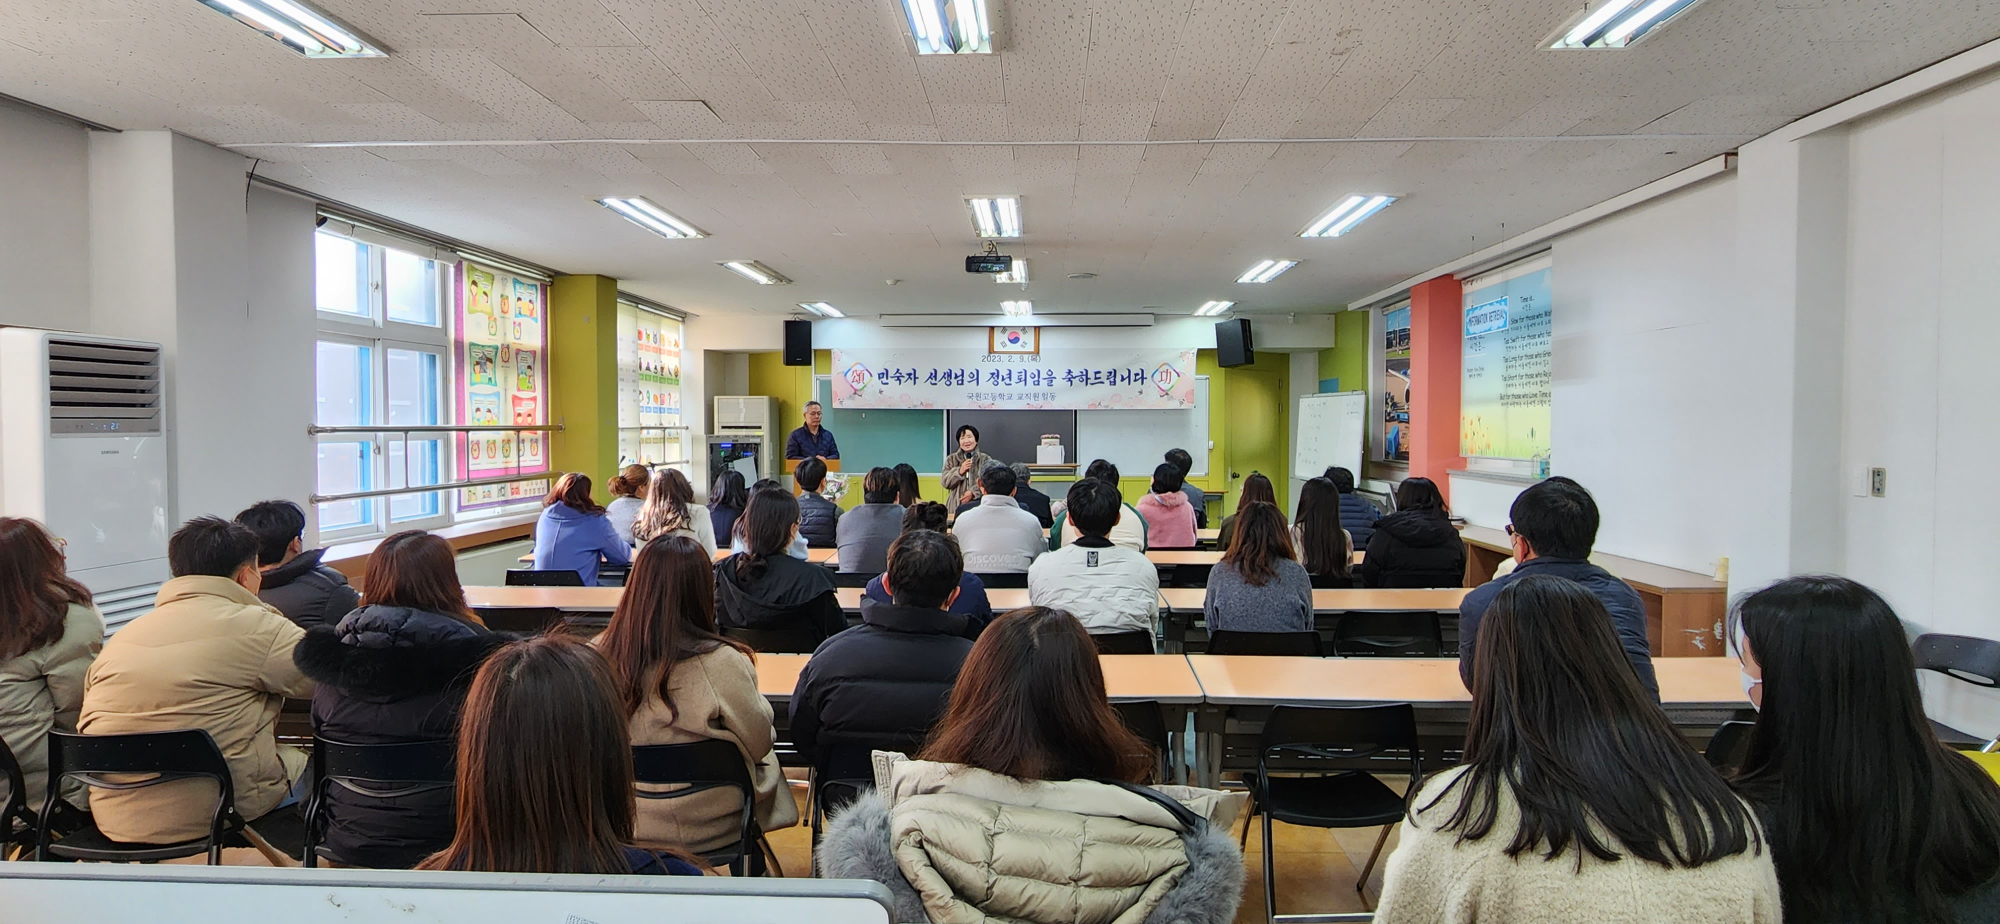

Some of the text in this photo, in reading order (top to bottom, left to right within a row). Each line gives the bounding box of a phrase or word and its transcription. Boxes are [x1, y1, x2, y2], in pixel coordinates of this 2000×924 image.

[1469, 314, 1488, 327] INFORMATION
[981, 354, 1004, 363] 2023.
[1008, 354, 1016, 363] 2.
[877, 367, 1148, 387] 민숙자 선생님의 정년퇴임을 축하드립니다
[1158, 368, 1172, 385] 功
[966, 392, 1014, 401] 국원고등학교
